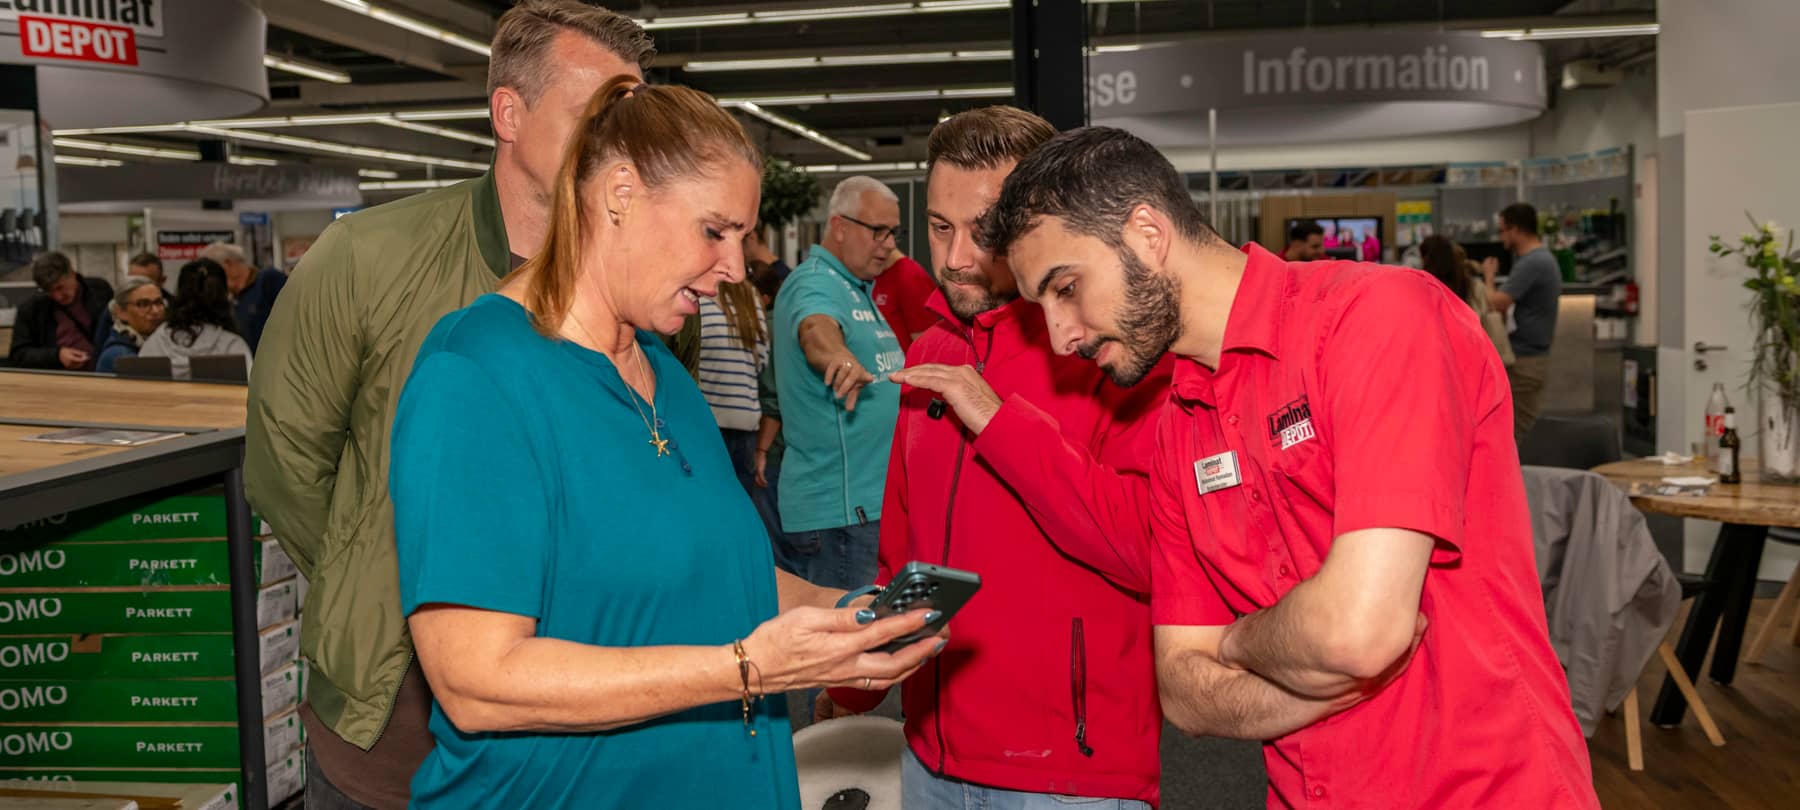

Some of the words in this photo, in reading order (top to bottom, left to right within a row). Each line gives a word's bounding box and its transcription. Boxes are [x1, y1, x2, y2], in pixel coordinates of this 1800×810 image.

[26, 19, 129, 61] DEPOT
[1243, 45, 1490, 95] Information
[132, 512, 200, 524] PARKETT
[0, 550, 66, 575] OMO
[129, 559, 198, 570] PARKETT
[0, 598, 62, 623] OMO
[125, 607, 193, 618] PARKETT
[0, 642, 69, 667] OMO
[131, 651, 200, 662] PARKETT
[0, 686, 68, 711] OMO
[131, 696, 198, 707] PARKETT
[0, 731, 73, 755] OMO
[136, 741, 203, 753] PARKETT
